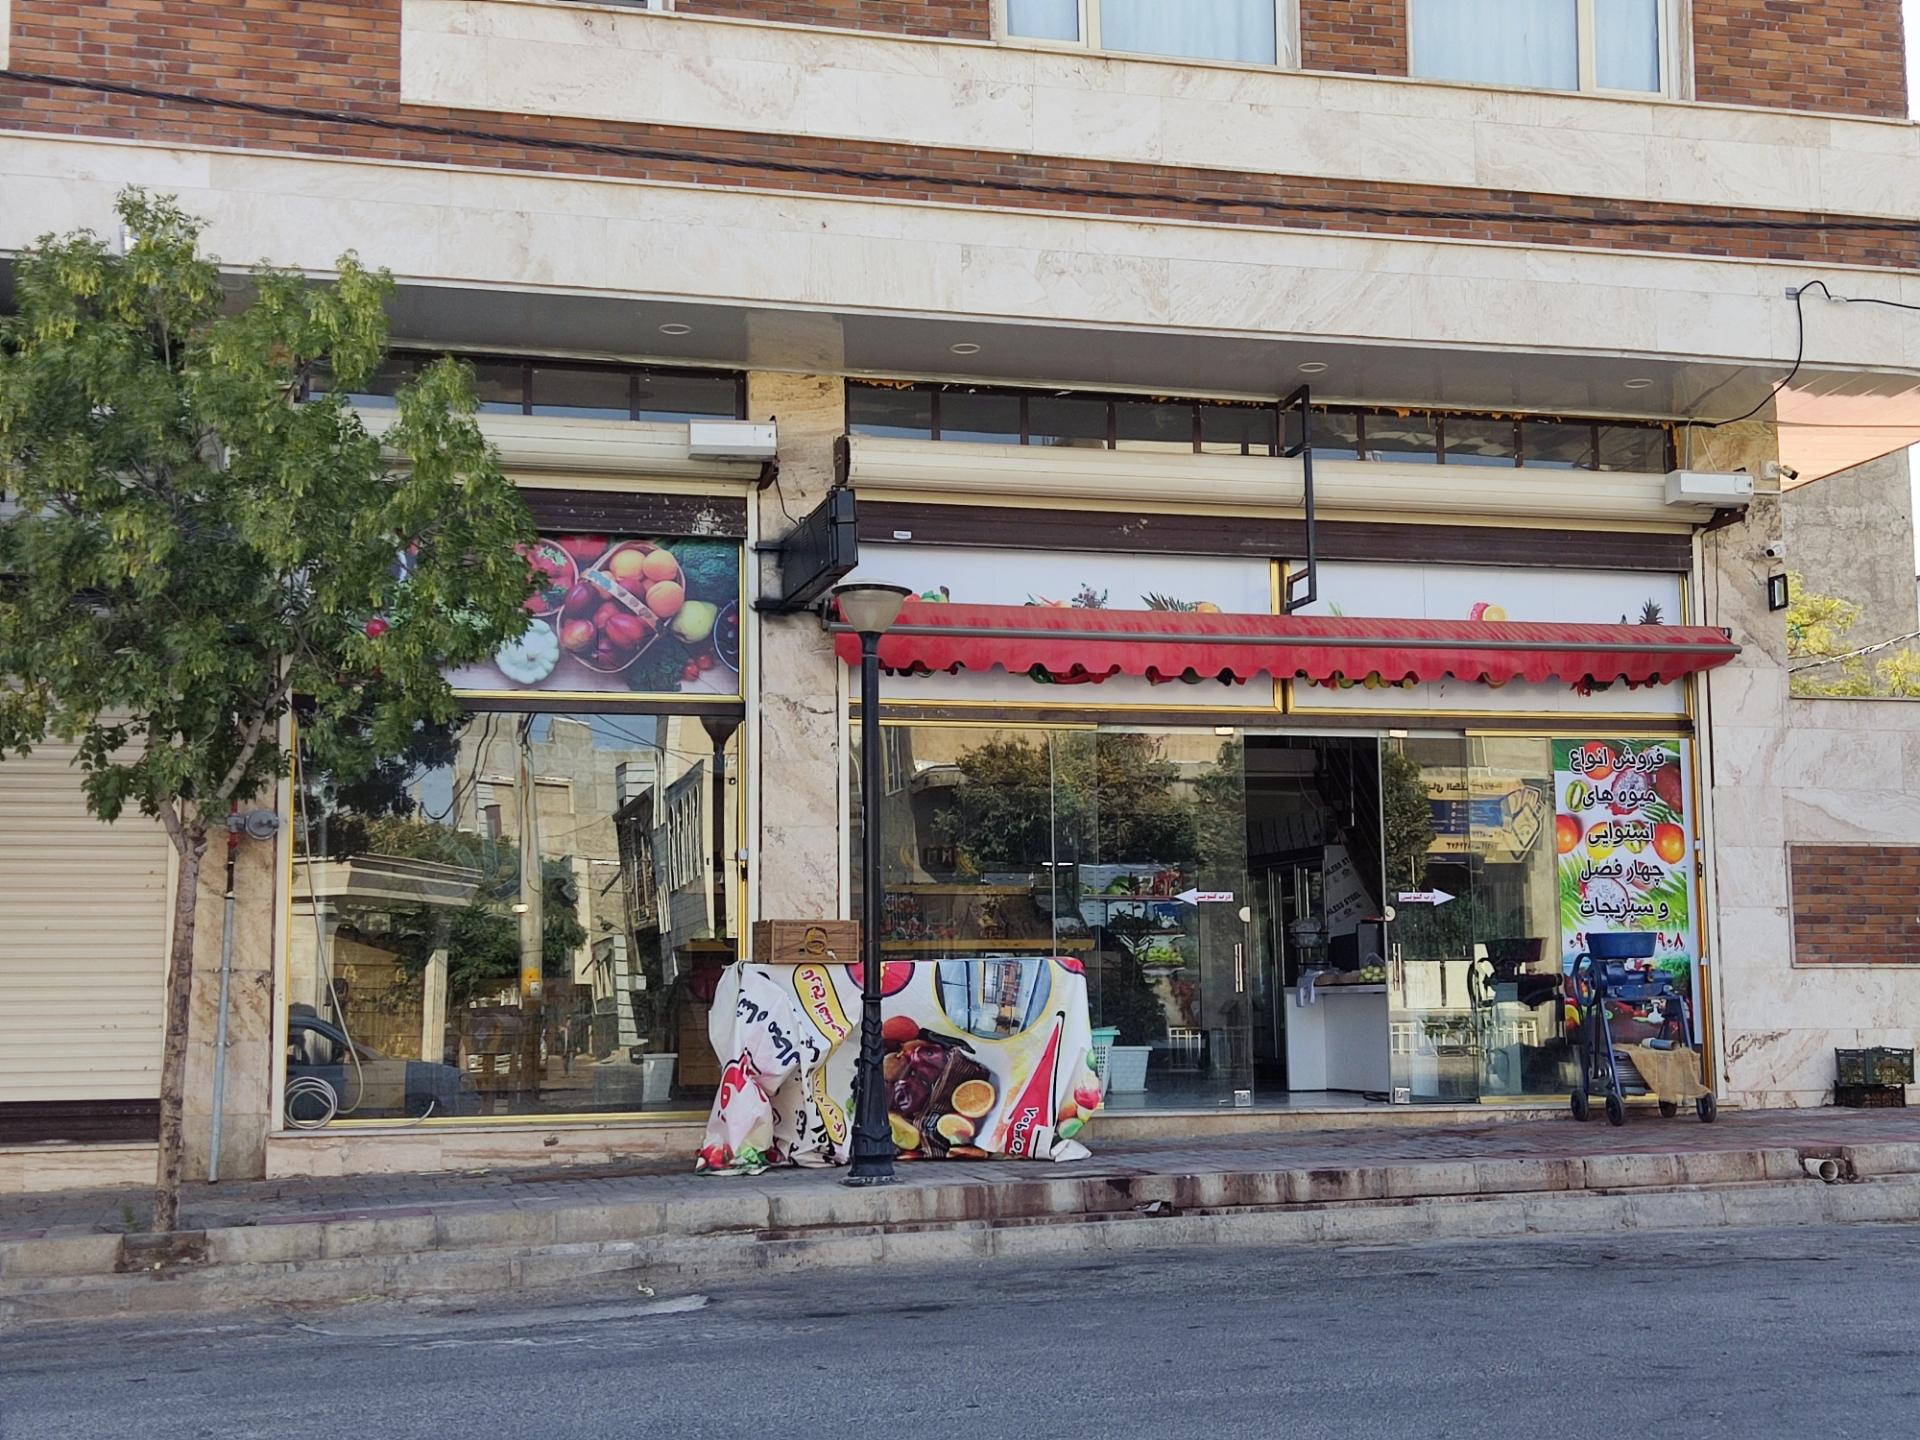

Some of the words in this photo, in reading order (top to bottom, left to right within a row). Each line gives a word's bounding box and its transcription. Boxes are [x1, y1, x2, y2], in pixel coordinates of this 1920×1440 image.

[1569, 748, 1608, 773] انواع
[1613, 746, 1665, 770] فروش
[1583, 785, 1613, 808] های
[1619, 788, 1656, 808] میوه
[1589, 822, 1655, 846] استوایی
[1581, 859, 1622, 882] فصل
[1627, 859, 1665, 886] چهار
[1581, 897, 1653, 919] سبزیجات
[1659, 904, 1669, 918] و
